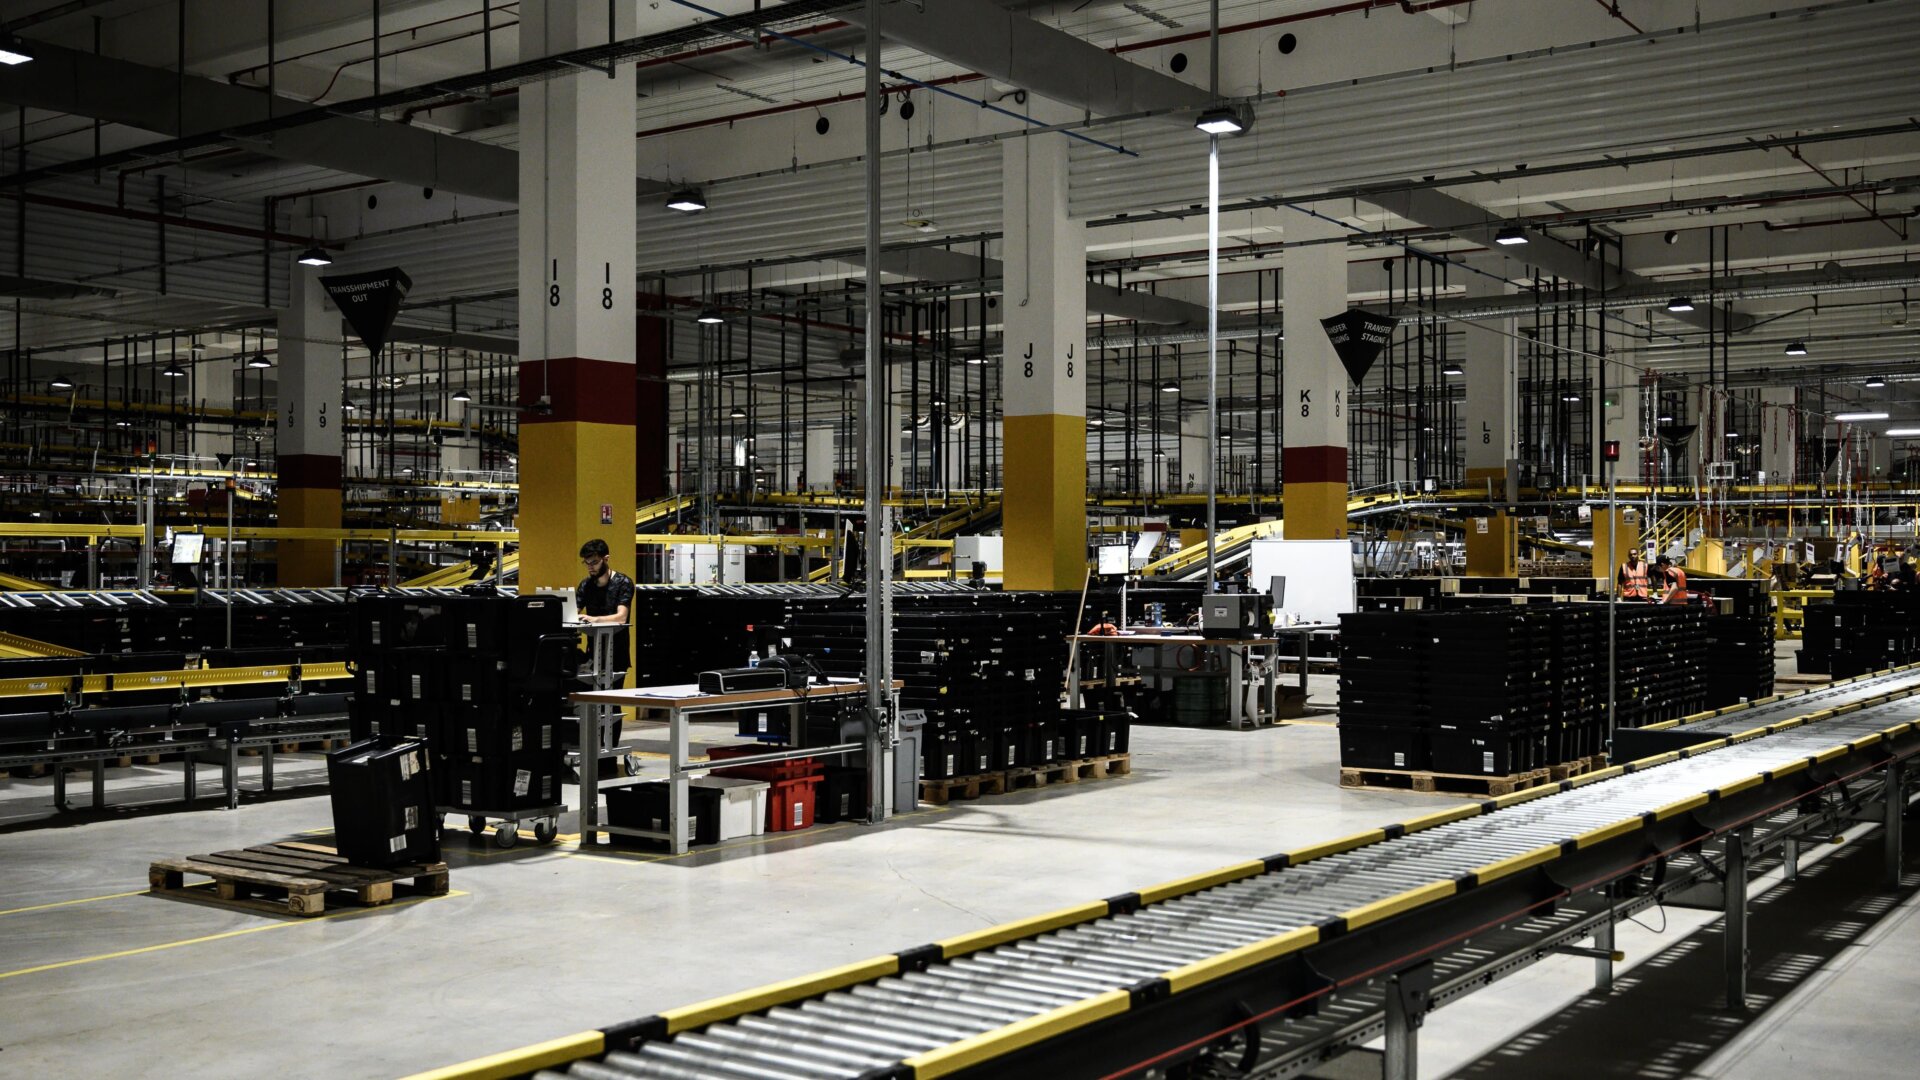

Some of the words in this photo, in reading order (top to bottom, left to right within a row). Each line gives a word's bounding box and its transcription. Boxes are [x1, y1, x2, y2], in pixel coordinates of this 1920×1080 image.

[329, 279, 391, 294] TRANSSHIPMENT
[352, 293, 368, 303] OUT
[549, 284, 560, 307] 8
[602, 287, 613, 310] 8
[1024, 342, 1033, 359] J
[1067, 343, 1073, 359] J
[1024, 361, 1033, 378] 8
[1067, 361, 1073, 378] 8
[1300, 389, 1311, 403] K
[1335, 389, 1340, 404] K
[288, 401, 294, 414] J
[319, 402, 326, 414] J
[1301, 404, 1309, 417] 8
[1335, 404, 1340, 418] 8
[288, 415, 294, 428] 9
[319, 416, 326, 428] 9
[1483, 421, 1491, 432] L
[1483, 433, 1490, 444] 8
[1188, 473, 1195, 481] N
